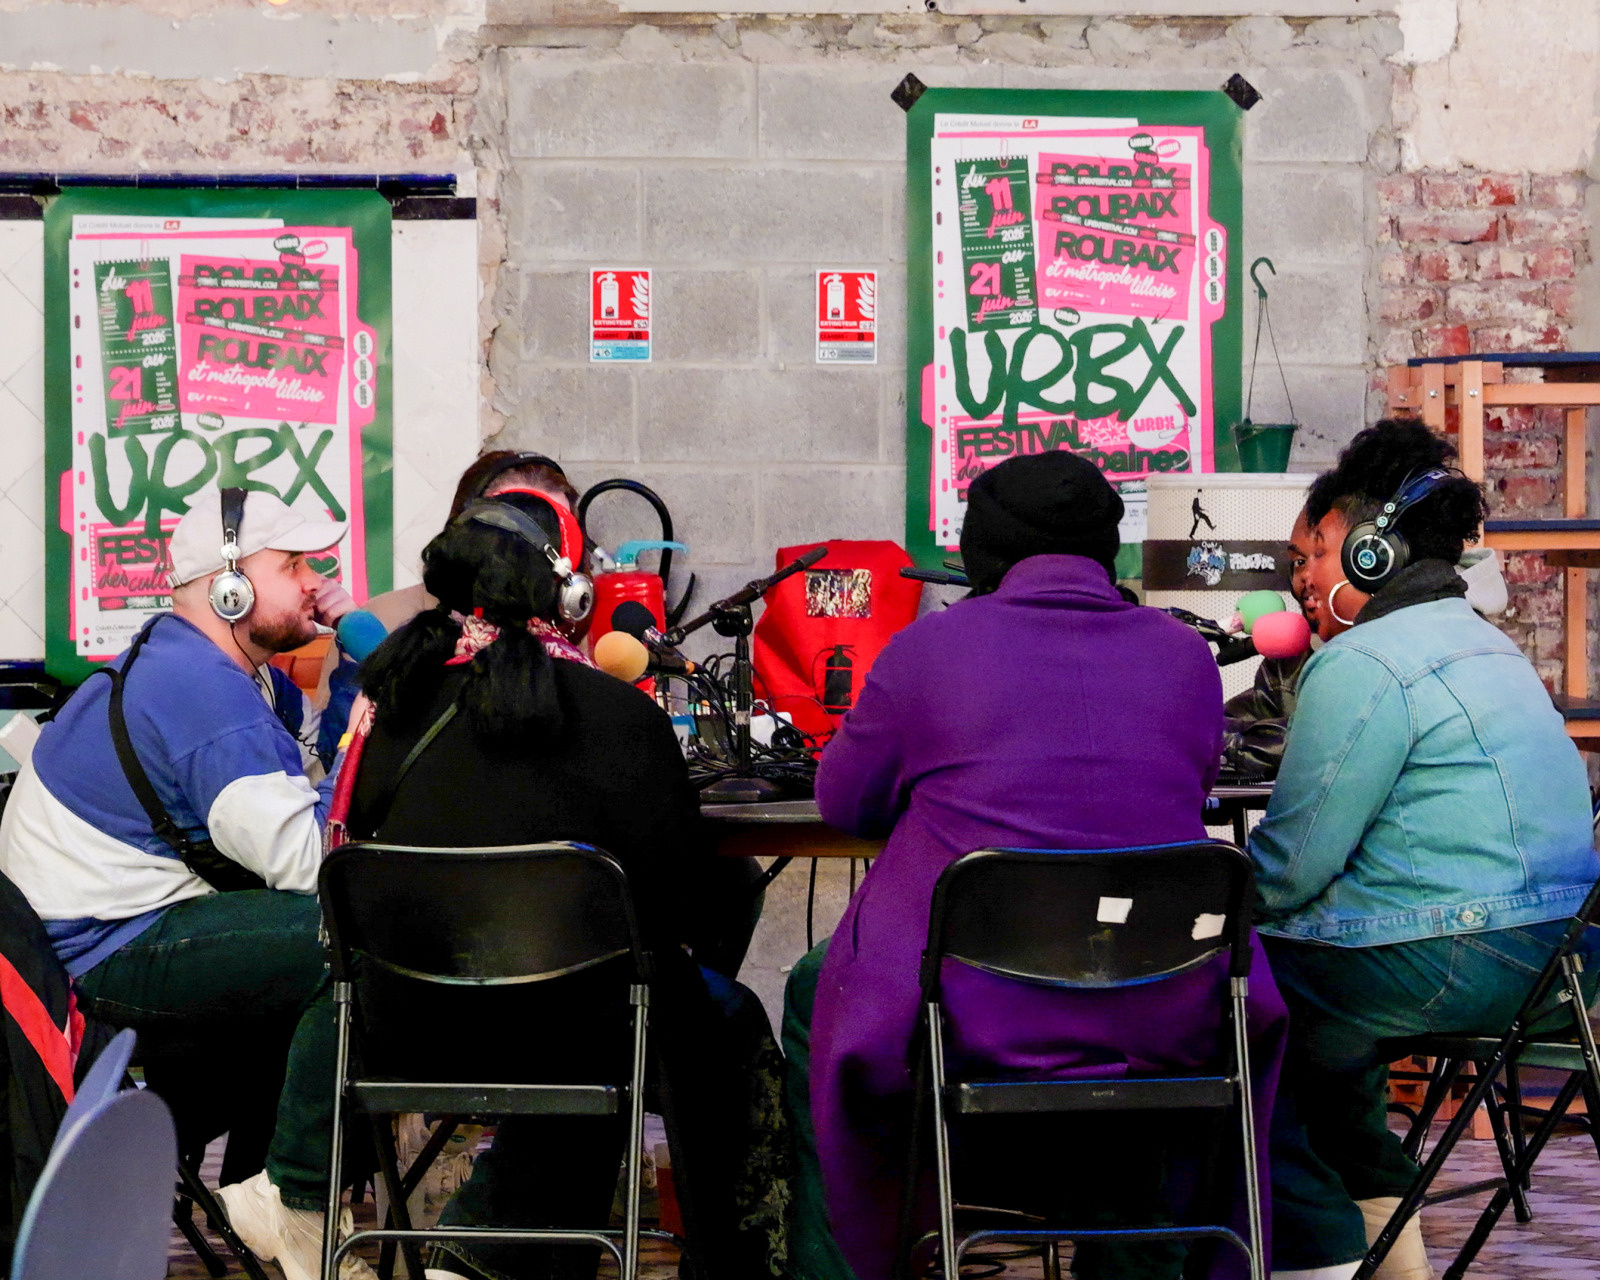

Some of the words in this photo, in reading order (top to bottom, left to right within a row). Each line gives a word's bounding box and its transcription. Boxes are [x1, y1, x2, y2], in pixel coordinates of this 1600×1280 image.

[1024, 120, 1037, 128] LA
[962, 164, 987, 189] du
[985, 177, 1013, 210] 11
[1052, 191, 1178, 218] ROUBAIX
[165, 221, 179, 229] LA
[986, 207, 1025, 239] juin
[1002, 249, 1026, 264] au
[1054, 231, 1182, 274] ROUBAIX
[101, 266, 127, 291] du
[969, 262, 1000, 295] 21
[1045, 257, 1067, 277] et
[1064, 259, 1136, 290] métropole
[1130, 274, 1177, 299] lilloise
[125, 279, 154, 314] 11
[194, 294, 326, 321] ROUBAIX
[976, 293, 1016, 323] juin
[127, 310, 167, 341] juin
[627, 331, 643, 340] AB
[858, 332, 865, 341] B
[142, 353, 168, 368] au
[197, 334, 329, 377] ROUBAIX
[108, 366, 141, 400] 21
[188, 360, 211, 381] et
[206, 362, 279, 393] métropole
[275, 377, 325, 402] lilloise
[949, 316, 1197, 430] URBX
[115, 399, 157, 429] juin
[1133, 415, 1175, 432] URBX
[957, 420, 1091, 458] FESTIVAL
